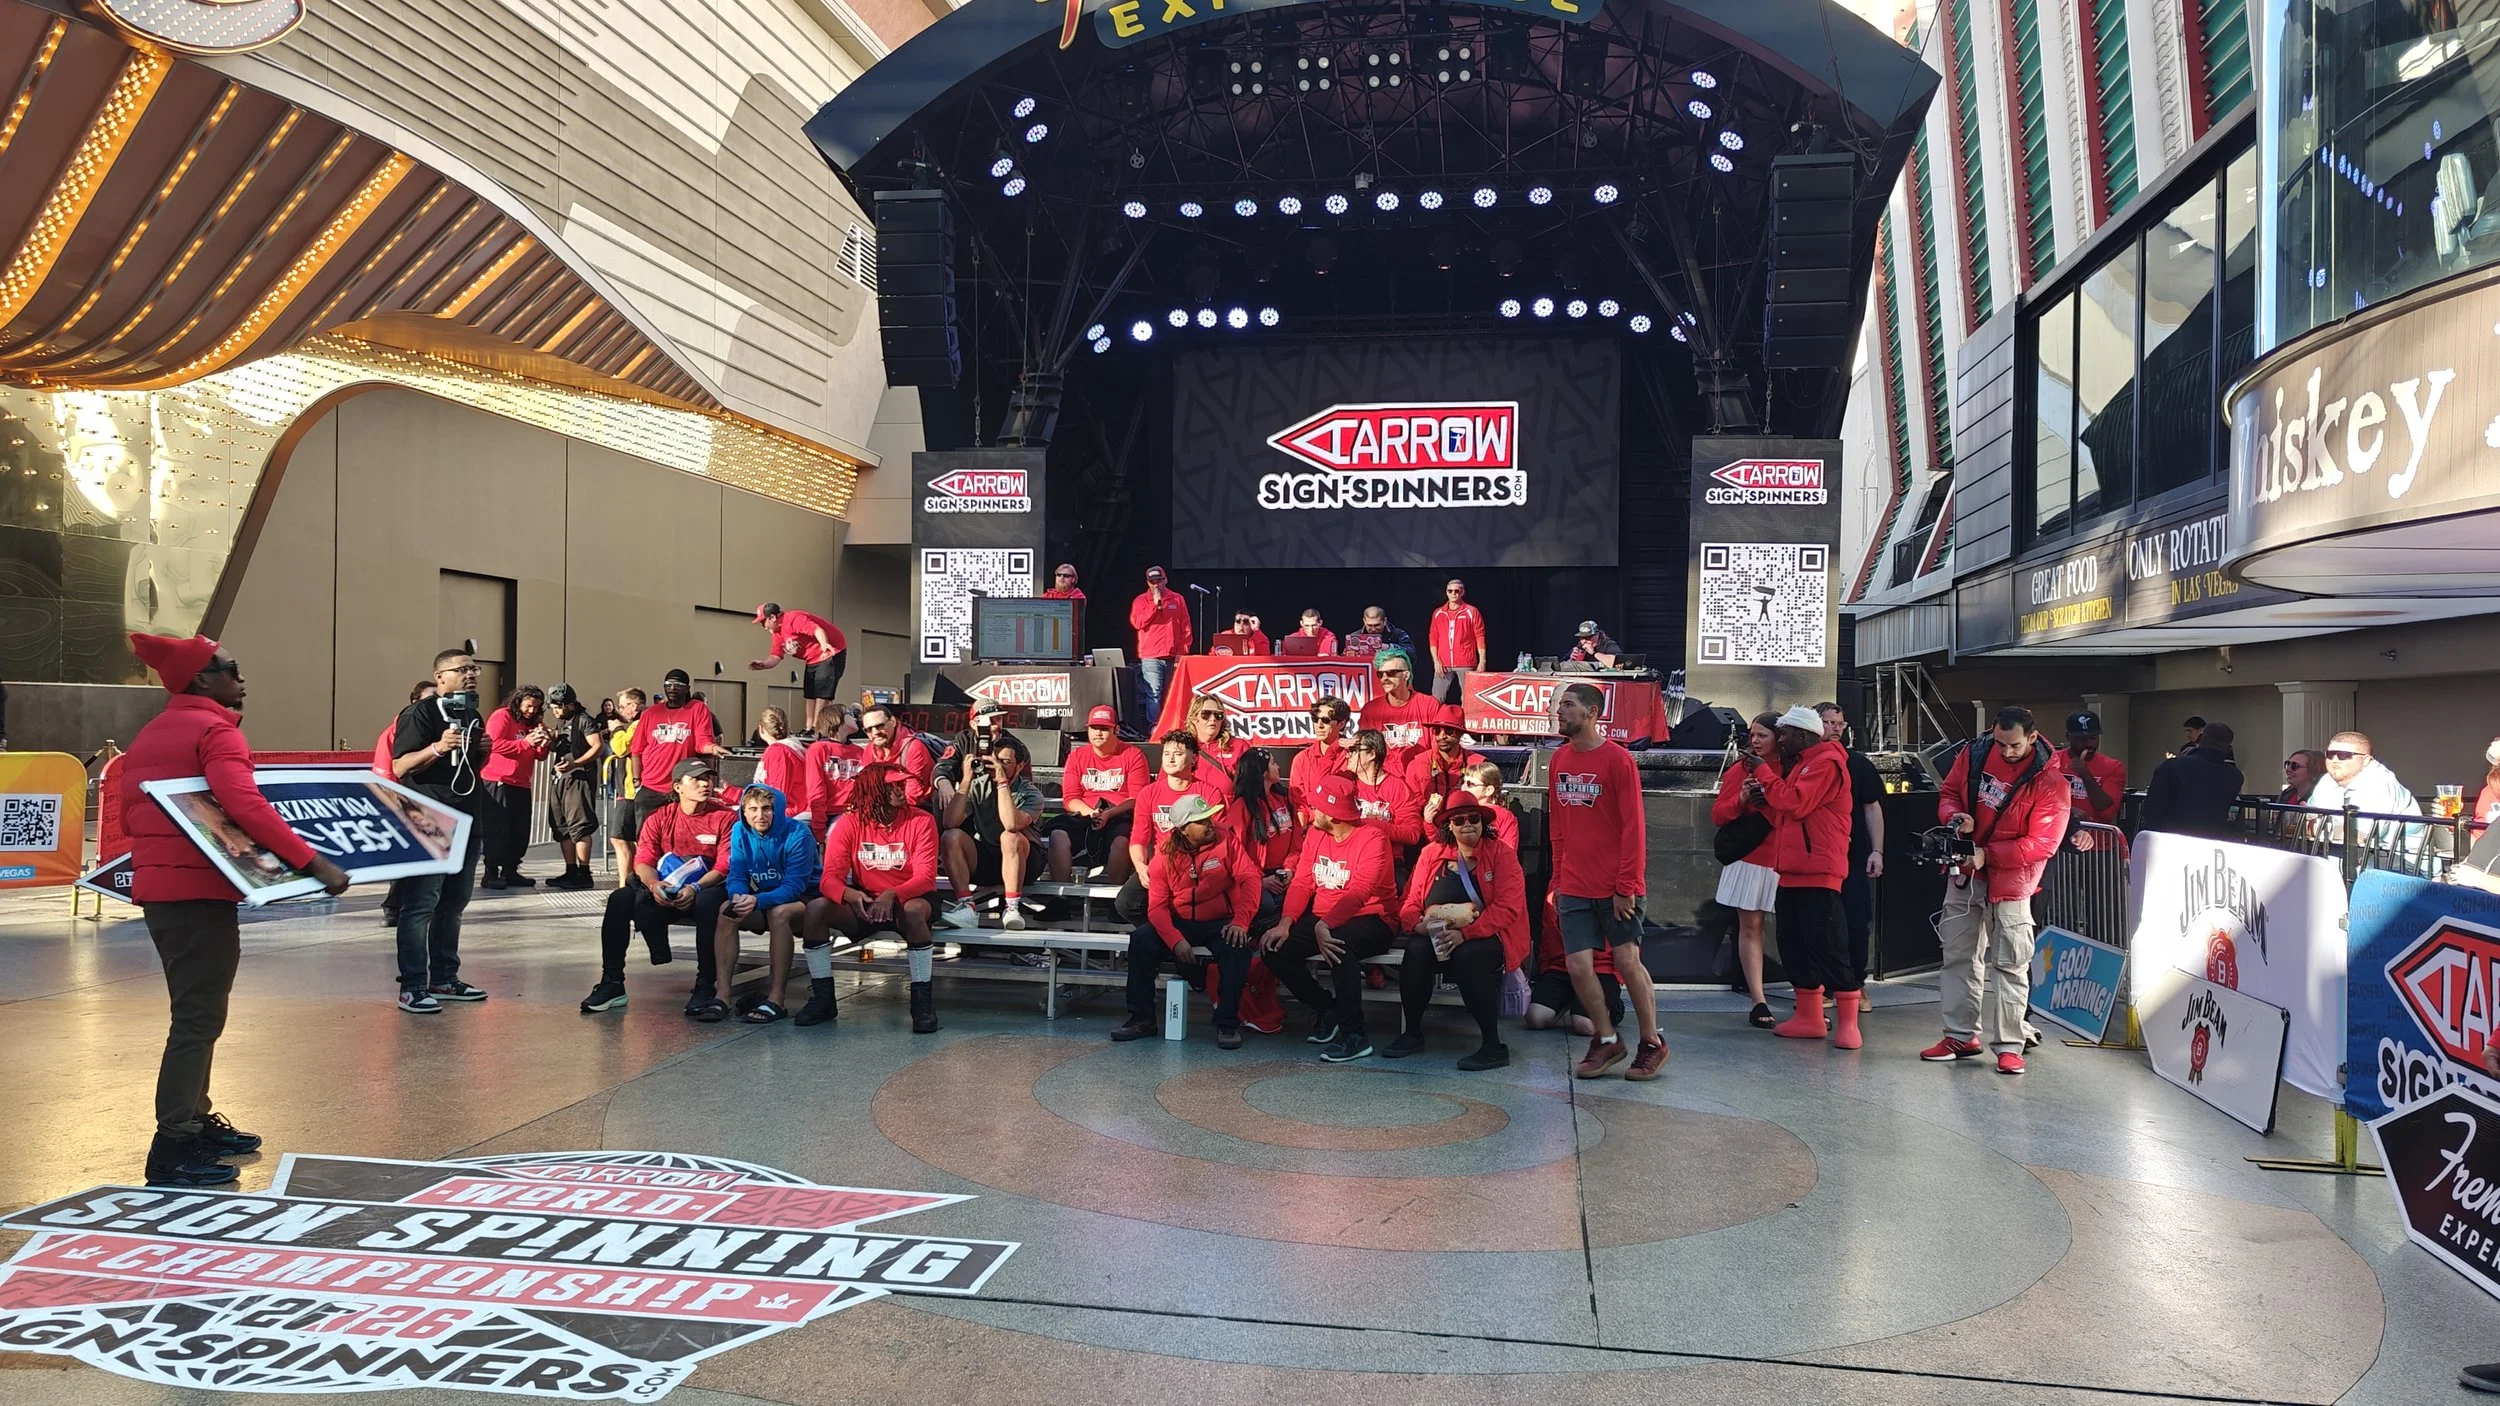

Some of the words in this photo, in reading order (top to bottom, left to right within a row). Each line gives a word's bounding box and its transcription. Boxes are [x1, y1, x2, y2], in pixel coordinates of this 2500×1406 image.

[927, 498, 1025, 510] SIGN-SPINNERS
[1263, 476, 1511, 504] SIGN-SPINNERS
[1708, 490, 1820, 502] SIGN-SPINNERS
[2129, 533, 2165, 581] ONLY
[2170, 513, 2229, 571] ROTATI
[2032, 567, 2064, 605] GREAT
[2066, 555, 2098, 597] FOOD
[2171, 579, 2181, 606] IN
[2183, 575, 2201, 603] LAS
[2081, 596, 2112, 623] KITCHEN
[2180, 864, 2210, 938] JIM
[2214, 848, 2268, 967] BEAM
[2057, 945, 2093, 982] GOOD
[2050, 979, 2112, 1022] MORNING!
[2181, 992, 2203, 1031] JIM
[2203, 989, 2228, 1050] BEAM
[447, 1182, 695, 1215] WORLD
[41, 1191, 364, 1242] SIGN
[357, 1211, 974, 1283] SPINNING
[97, 1244, 754, 1312] CHAMPIONSHIP
